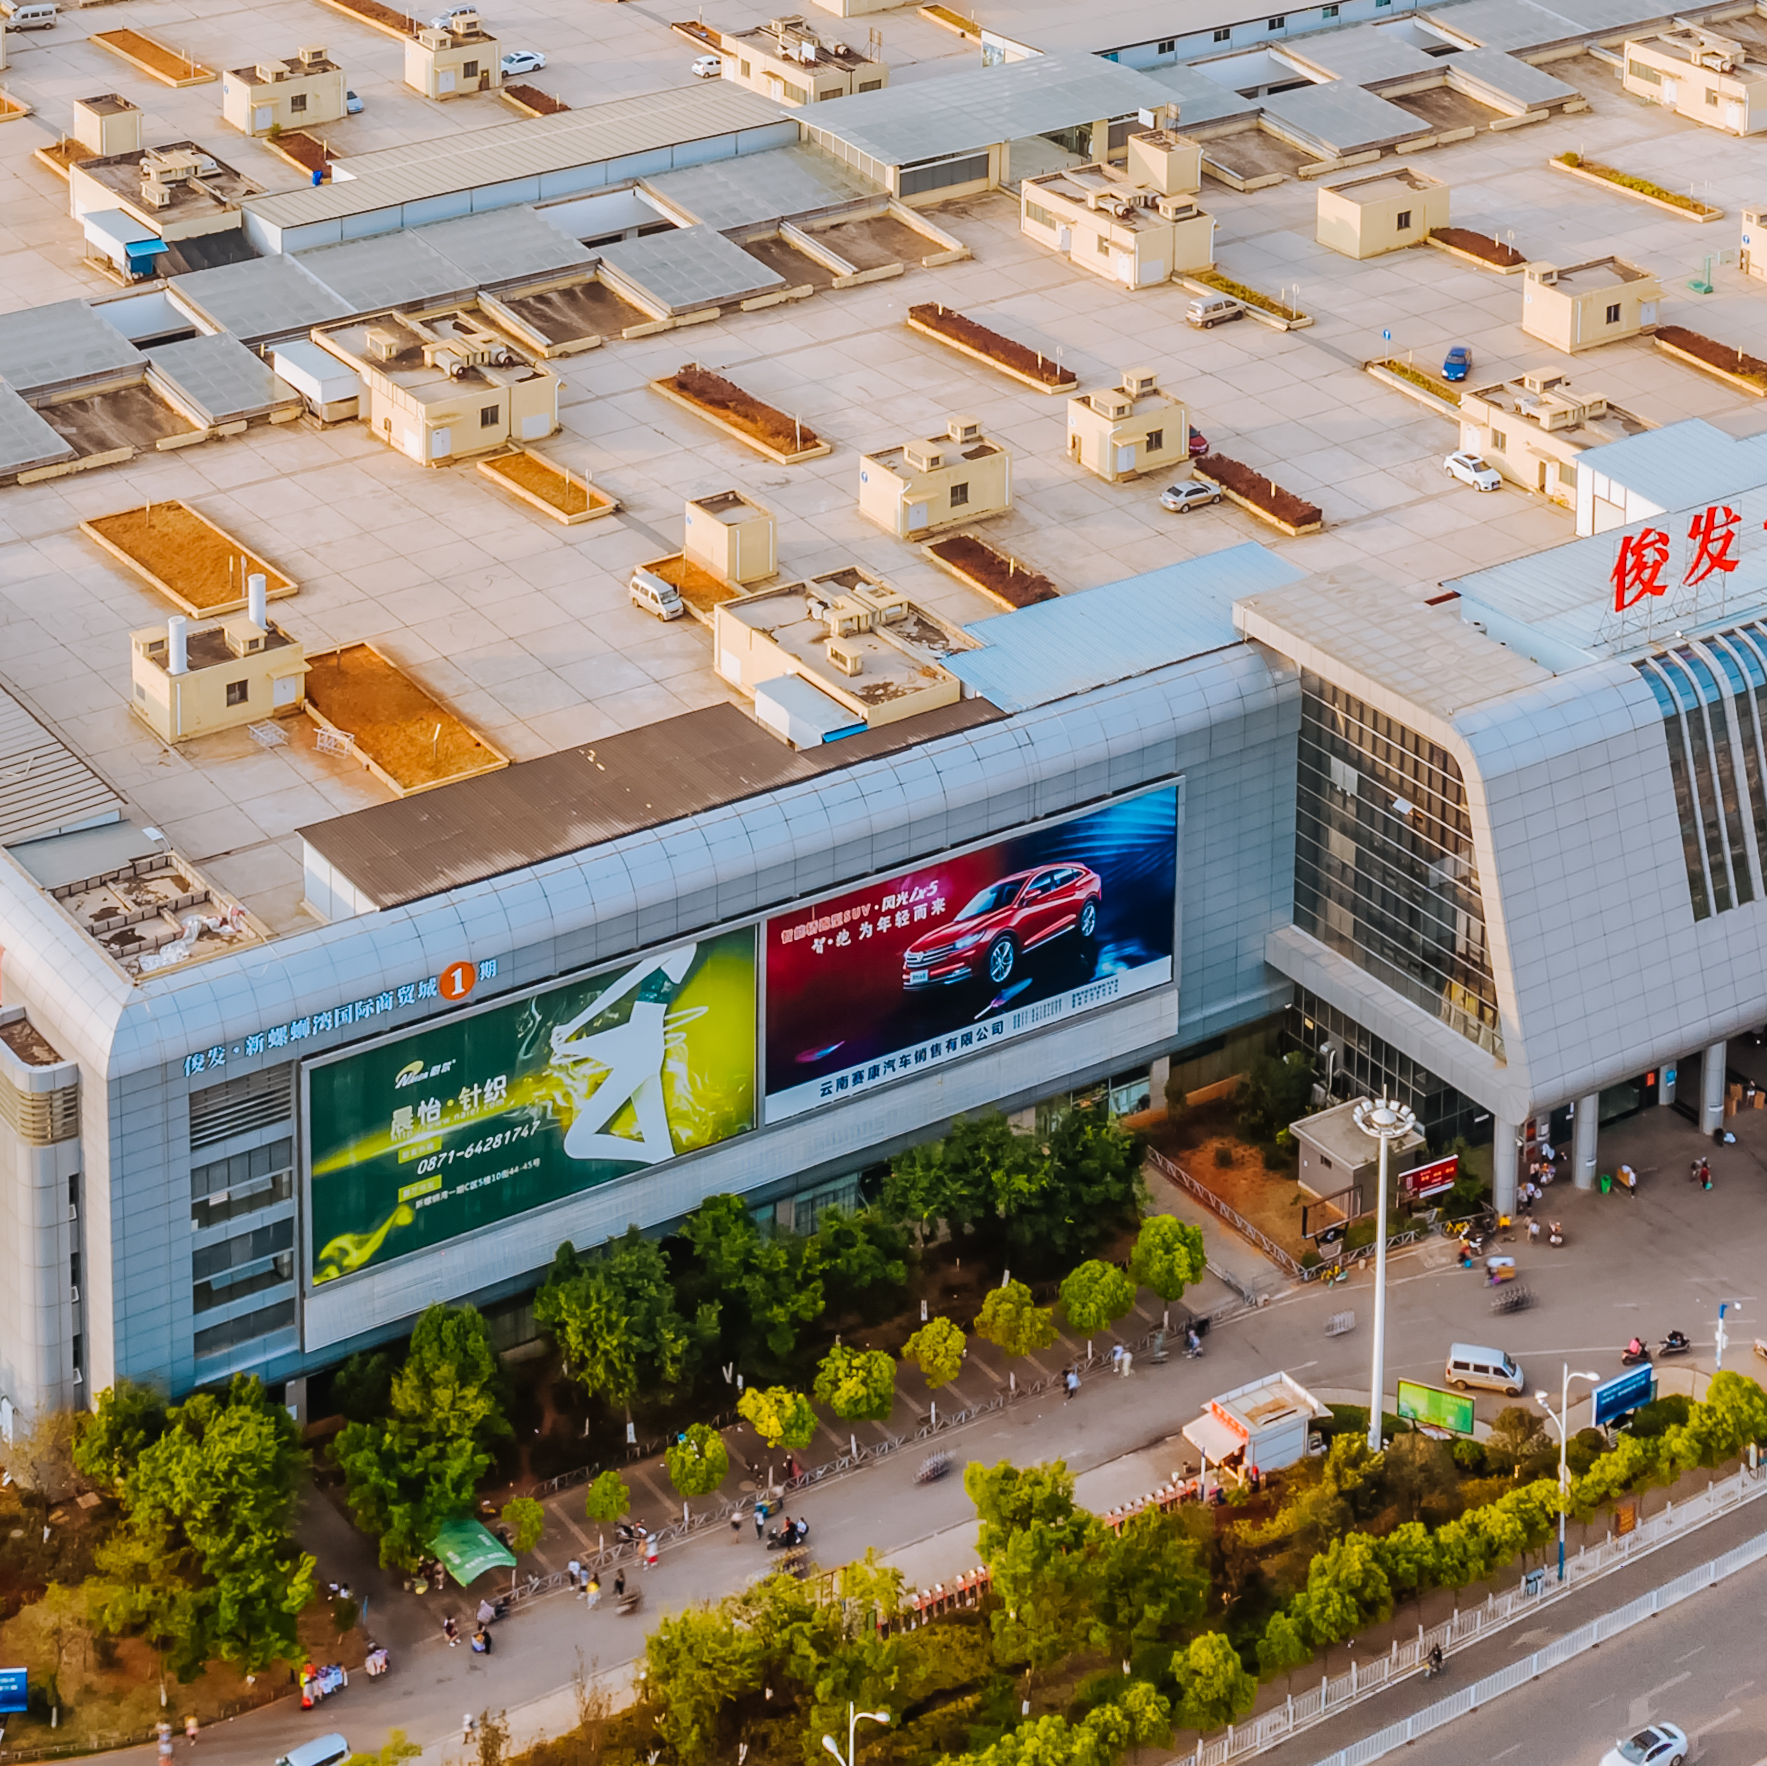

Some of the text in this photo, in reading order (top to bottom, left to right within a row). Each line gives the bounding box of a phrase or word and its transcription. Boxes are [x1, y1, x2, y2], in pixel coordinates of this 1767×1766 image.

[858, 897, 946, 940] 为年轻而来
[819, 1019, 1005, 1098] 云南赛康汽车销售有限公司
[417, 1120, 541, 1175] 0871-64281747
